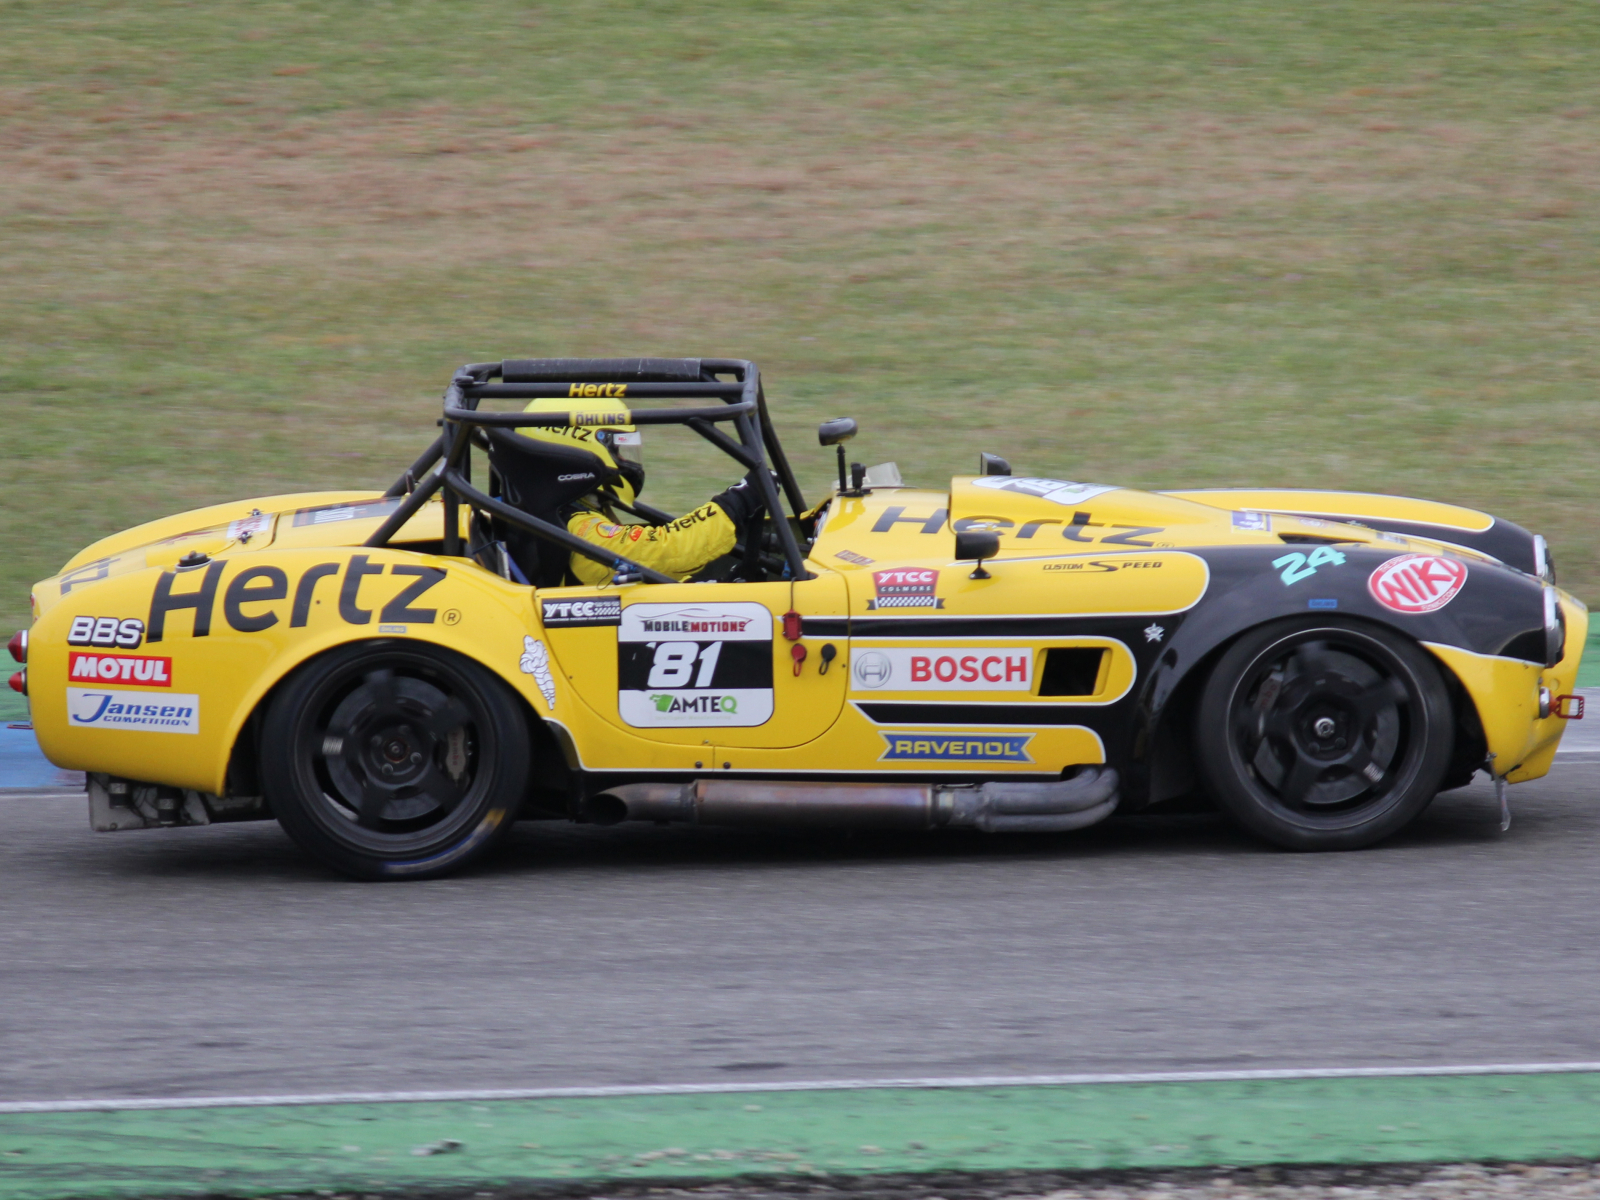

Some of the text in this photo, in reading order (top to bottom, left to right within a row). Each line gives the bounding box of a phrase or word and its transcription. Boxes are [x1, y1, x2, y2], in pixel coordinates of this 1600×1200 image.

[568, 383, 627, 397] Hertz
[575, 411, 626, 425] ÖHLINS
[538, 426, 592, 442] ertz
[557, 472, 595, 481] COBRA
[665, 505, 717, 533] Hertz
[870, 506, 1166, 547] Hertz
[1042, 563, 1084, 571] CUSTOM
[1272, 546, 1347, 586] 24
[878, 571, 934, 583] YTCC
[1380, 557, 1460, 606] NIKI
[146, 554, 448, 643] Hertz
[543, 602, 595, 617] YTCC
[67, 615, 145, 649] BBS
[72, 656, 168, 681] MOTUL
[910, 656, 1027, 682] BOSCH
[72, 693, 193, 723] Jansen
[668, 695, 738, 714] AMTEQ
[103, 715, 190, 726] COMPETITION
[895, 739, 1019, 756] RAVENOL
